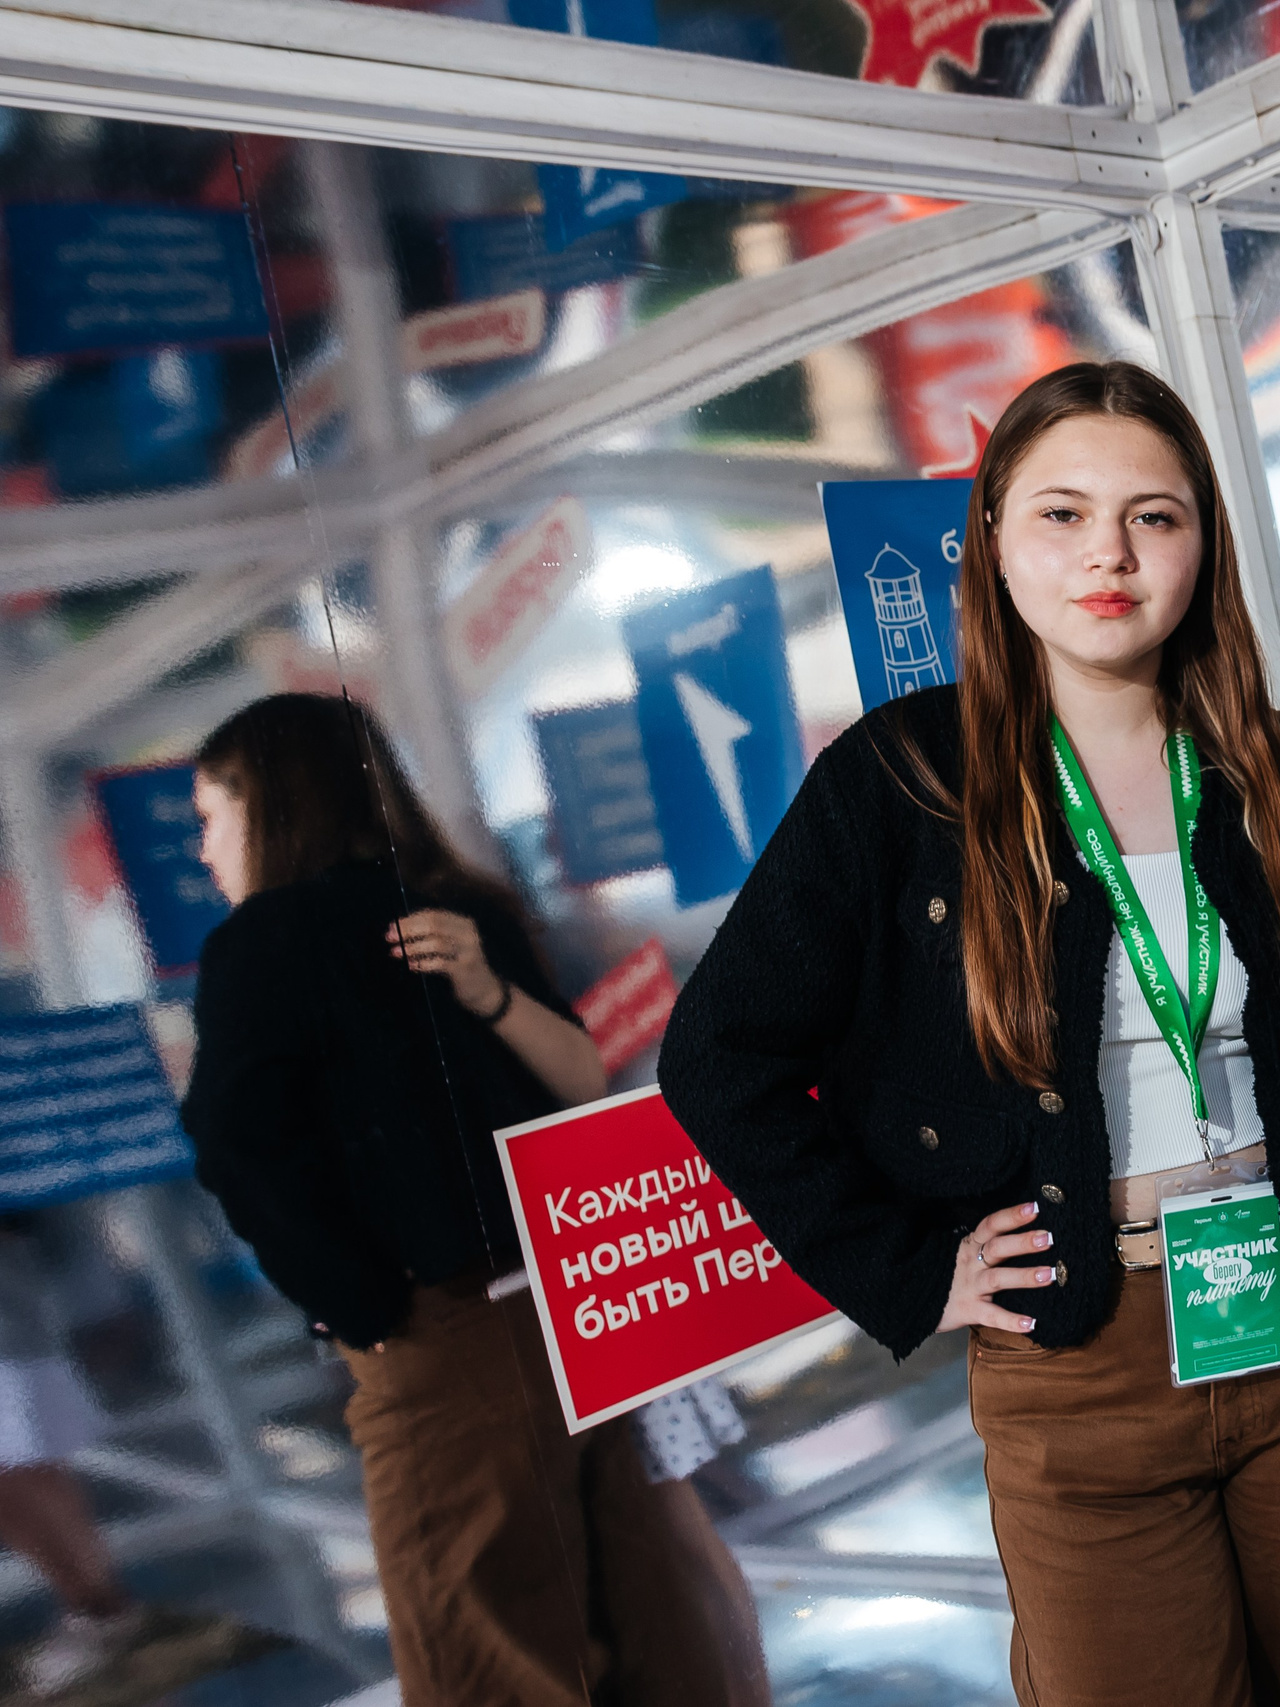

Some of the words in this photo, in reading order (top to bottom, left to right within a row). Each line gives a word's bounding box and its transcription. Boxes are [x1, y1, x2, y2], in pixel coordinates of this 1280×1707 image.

[560, 1199, 711, 1289] новый
[1172, 1236, 1279, 1271] УЧАСТНИК
[1212, 1262, 1242, 1281] берегу
[574, 1276, 690, 1340] быть
